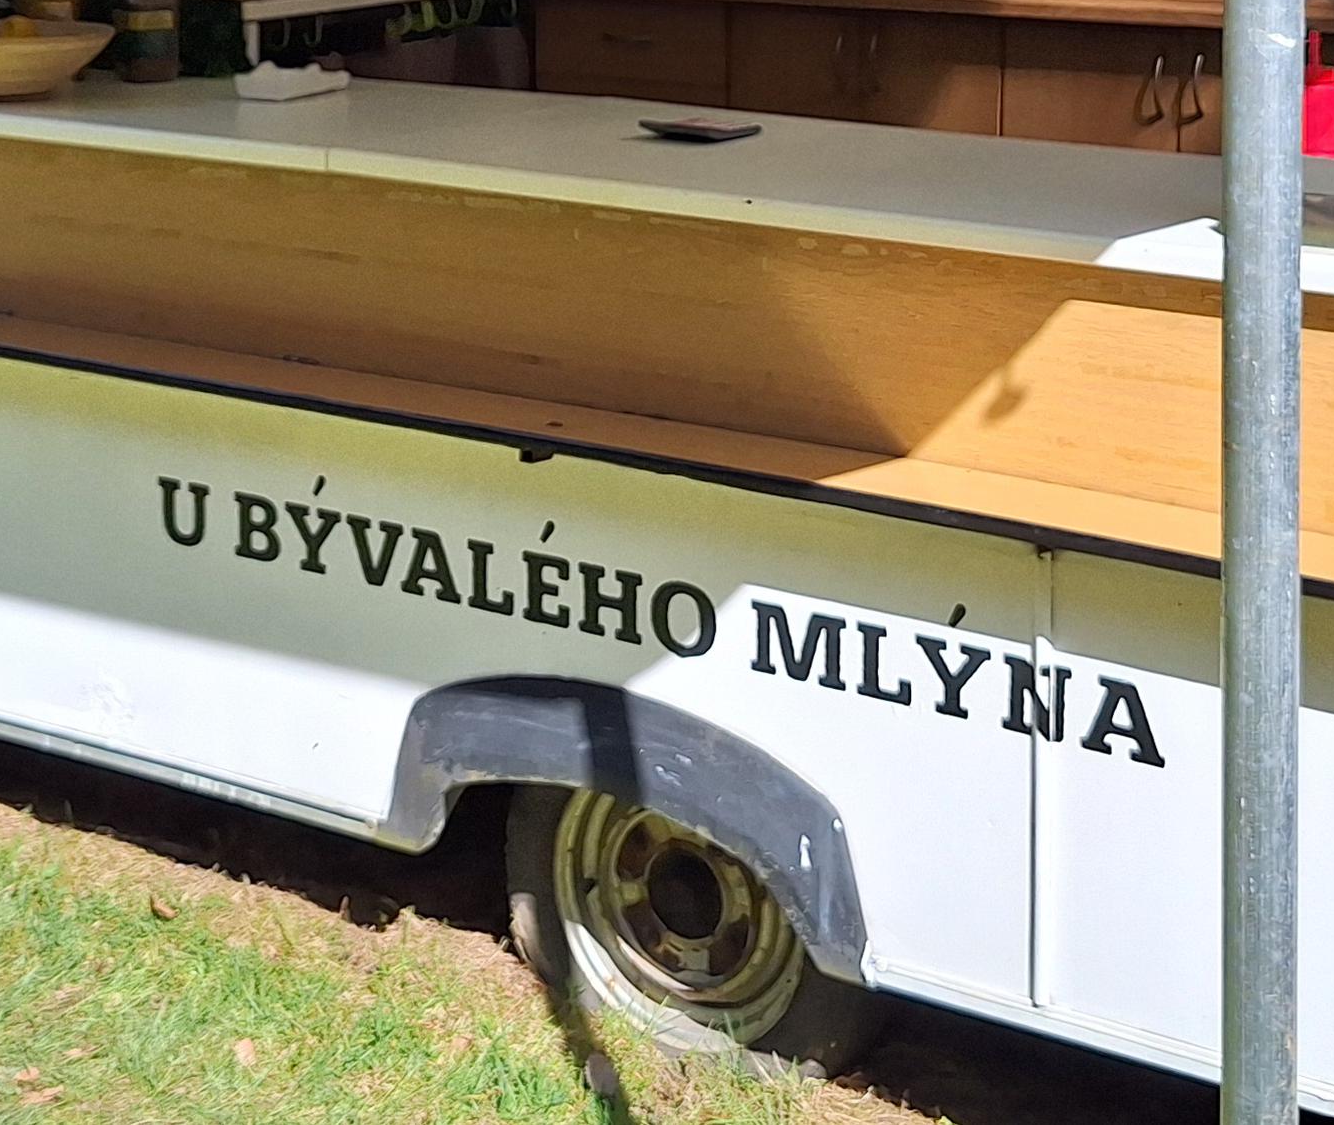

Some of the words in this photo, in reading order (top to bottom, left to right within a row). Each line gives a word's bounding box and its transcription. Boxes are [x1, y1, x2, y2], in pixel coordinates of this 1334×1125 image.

[158, 475, 209, 546] U
[234, 475, 717, 657] BÝVALÉHO
[750, 598, 1165, 768] MLÝNA
